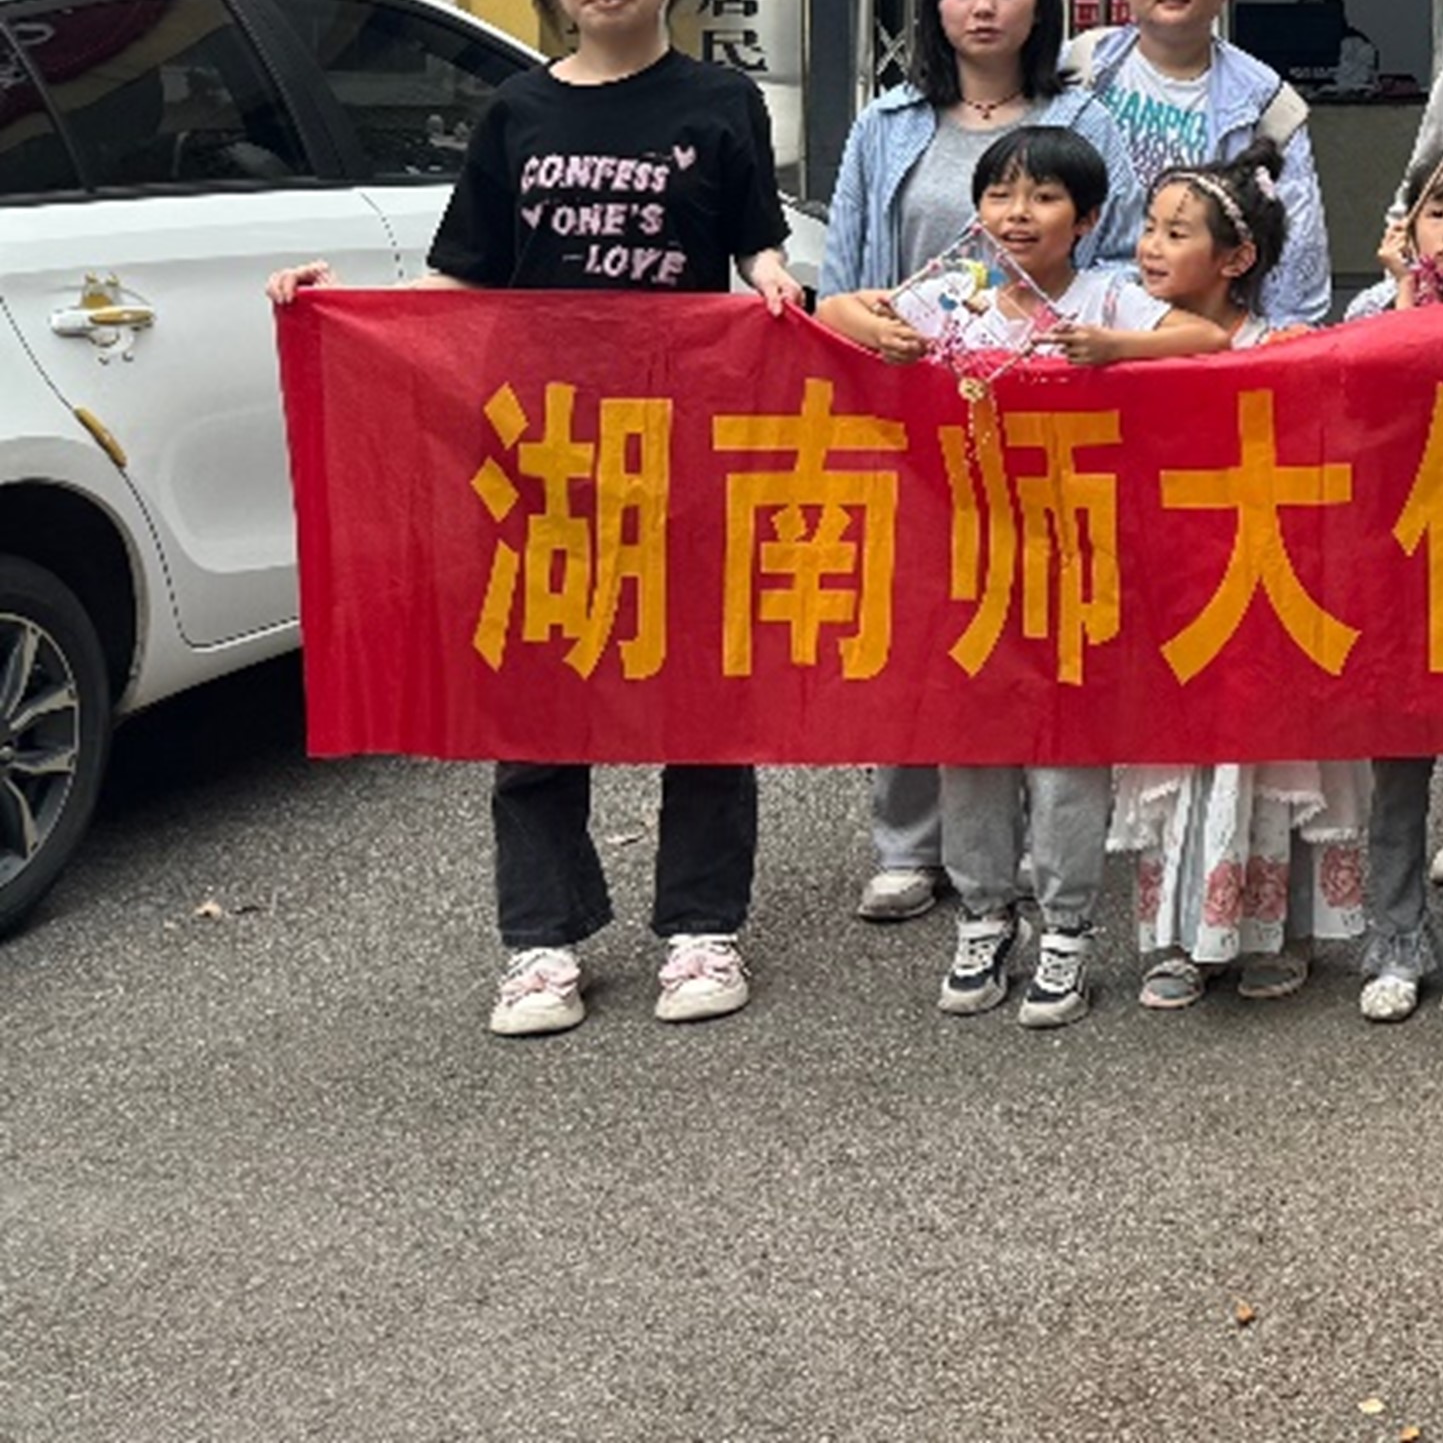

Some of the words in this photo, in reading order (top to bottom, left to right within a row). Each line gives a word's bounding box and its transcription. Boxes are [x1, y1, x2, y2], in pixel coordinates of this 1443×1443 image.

[520, 154, 671, 194] CONFESS
[551, 203, 665, 237] ONE'S
[584, 243, 688, 286] LOVE
